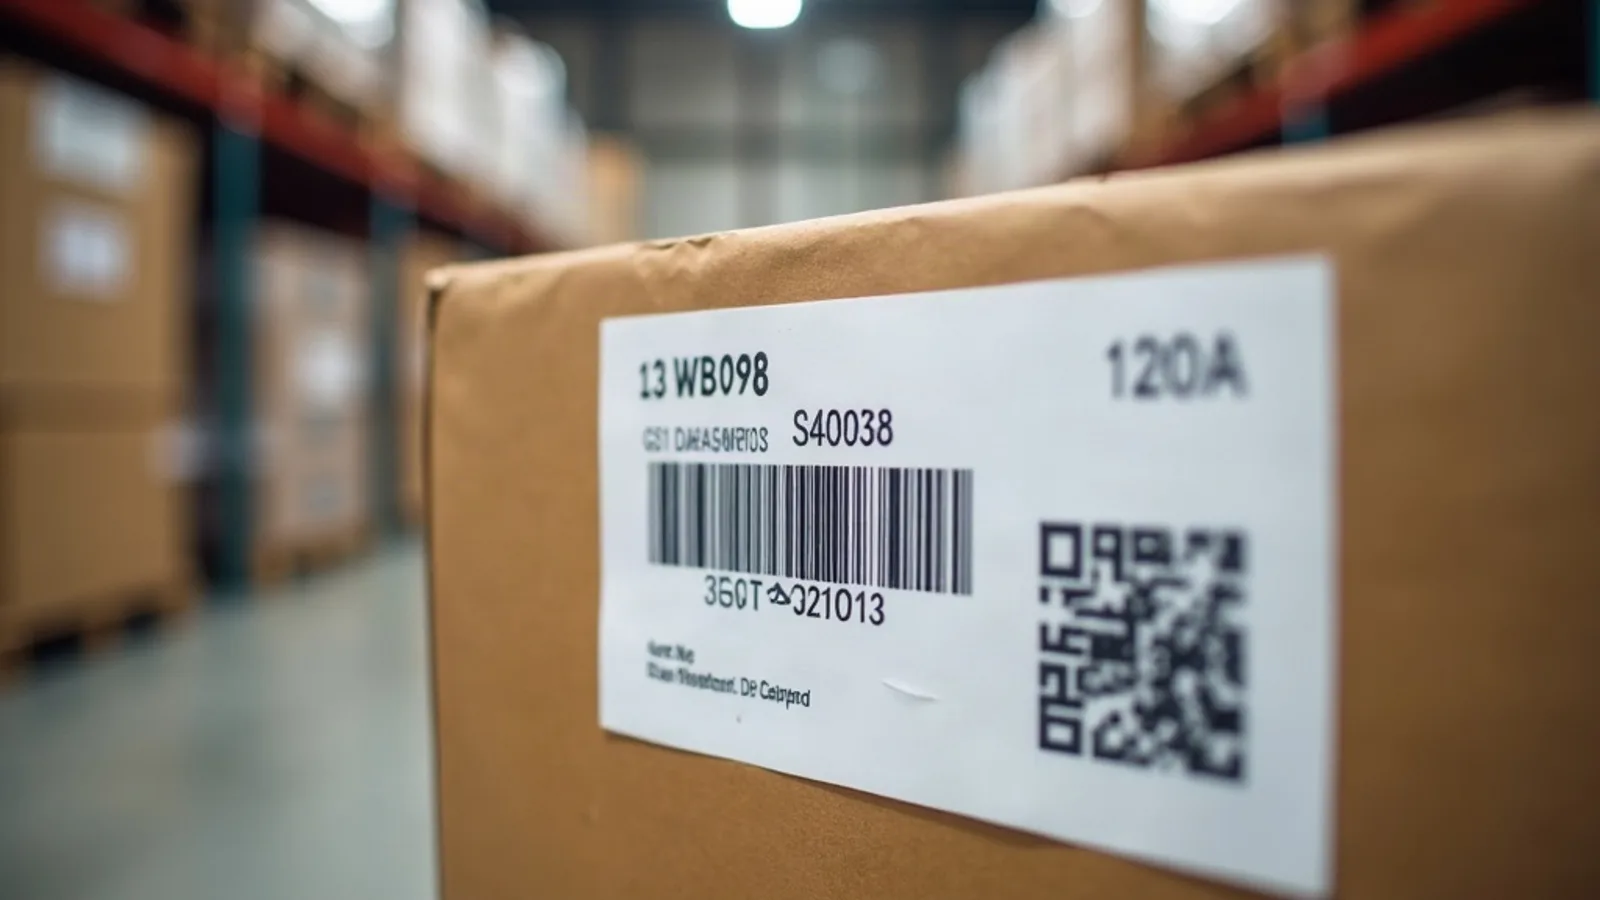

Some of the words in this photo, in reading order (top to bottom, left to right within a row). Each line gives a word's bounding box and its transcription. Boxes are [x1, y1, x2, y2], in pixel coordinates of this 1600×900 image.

[639, 359, 666, 399] 13
[674, 351, 769, 397] WB098
[1106, 331, 1249, 401] 120A
[792, 408, 894, 447] S40038
